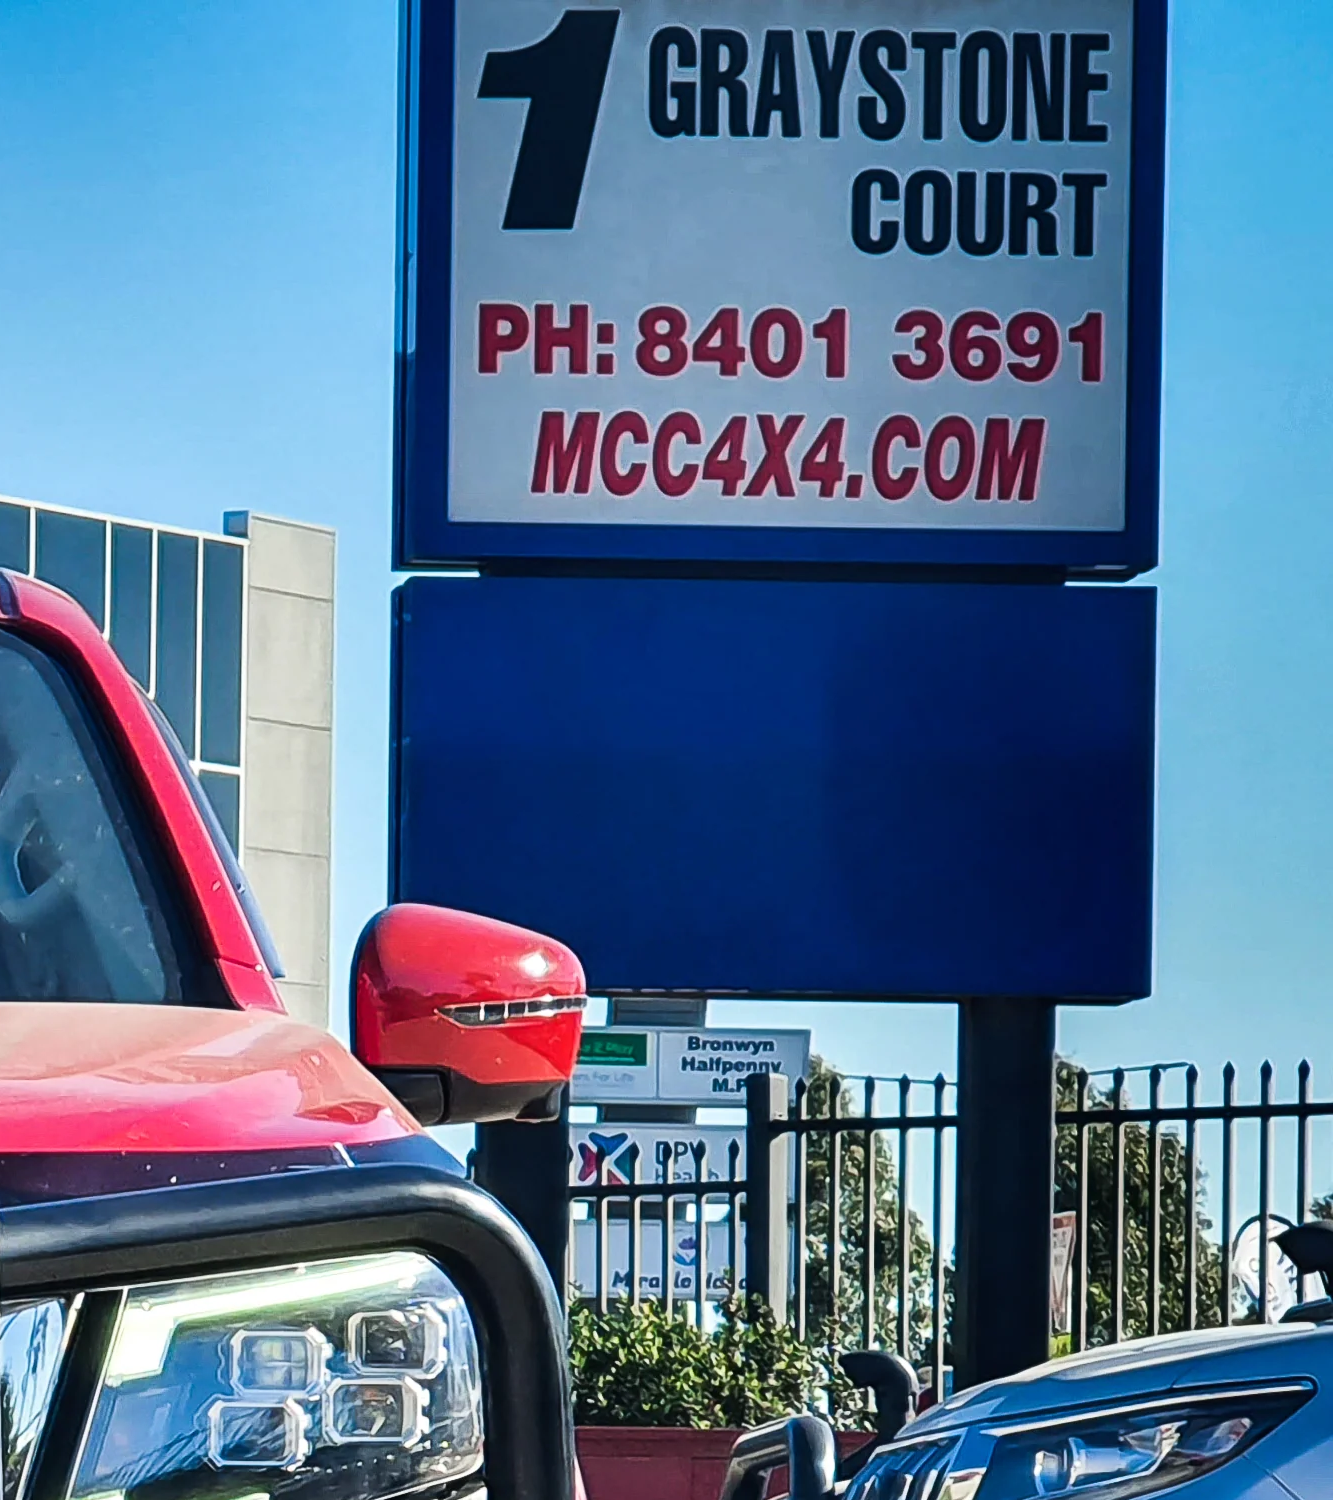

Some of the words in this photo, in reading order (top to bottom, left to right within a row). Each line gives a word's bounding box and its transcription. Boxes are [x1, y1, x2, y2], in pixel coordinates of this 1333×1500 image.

[476, 8, 621, 230] 1
[647, 26, 1111, 142] GRAYSTONE
[850, 168, 1108, 257] COURT
[477, 301, 615, 376] PH:
[634, 305, 849, 380] 8401
[891, 309, 1104, 384] 3691
[529, 409, 1046, 502] MCC4X4.COM
[686, 1035, 775, 1055] Bronwyn
